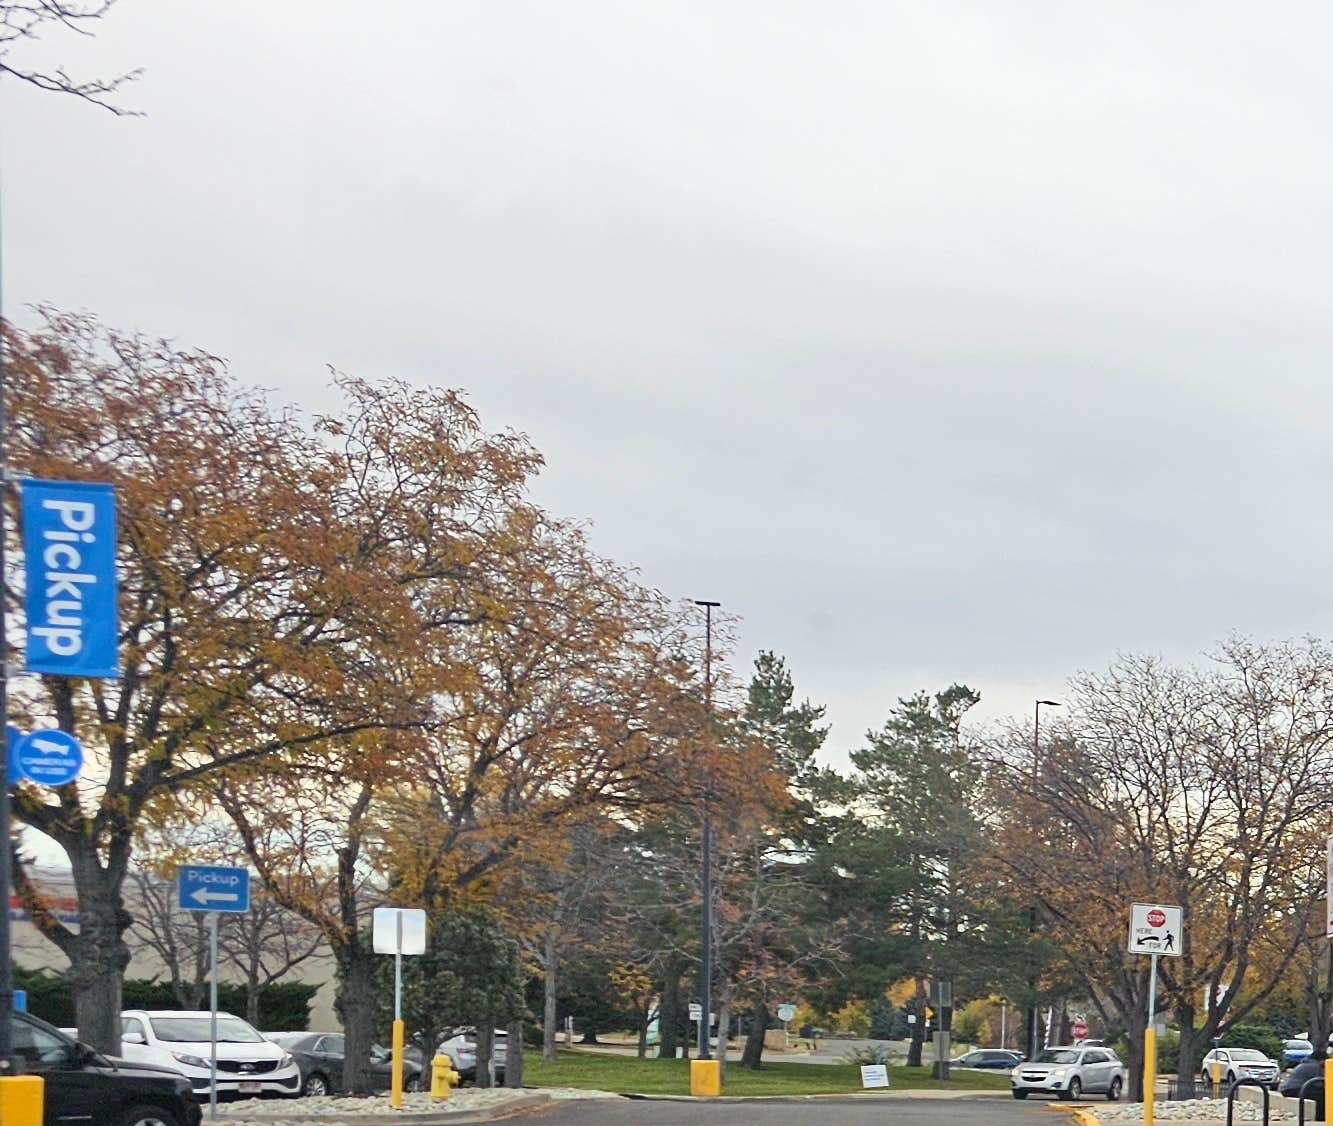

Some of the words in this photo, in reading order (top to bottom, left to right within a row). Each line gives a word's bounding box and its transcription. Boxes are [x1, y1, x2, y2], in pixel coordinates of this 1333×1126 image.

[31, 499, 97, 657] Pickup
[187, 869, 239, 888] Pickup
[1147, 914, 1166, 922] STOP
[1136, 927, 1152, 935] HERE
